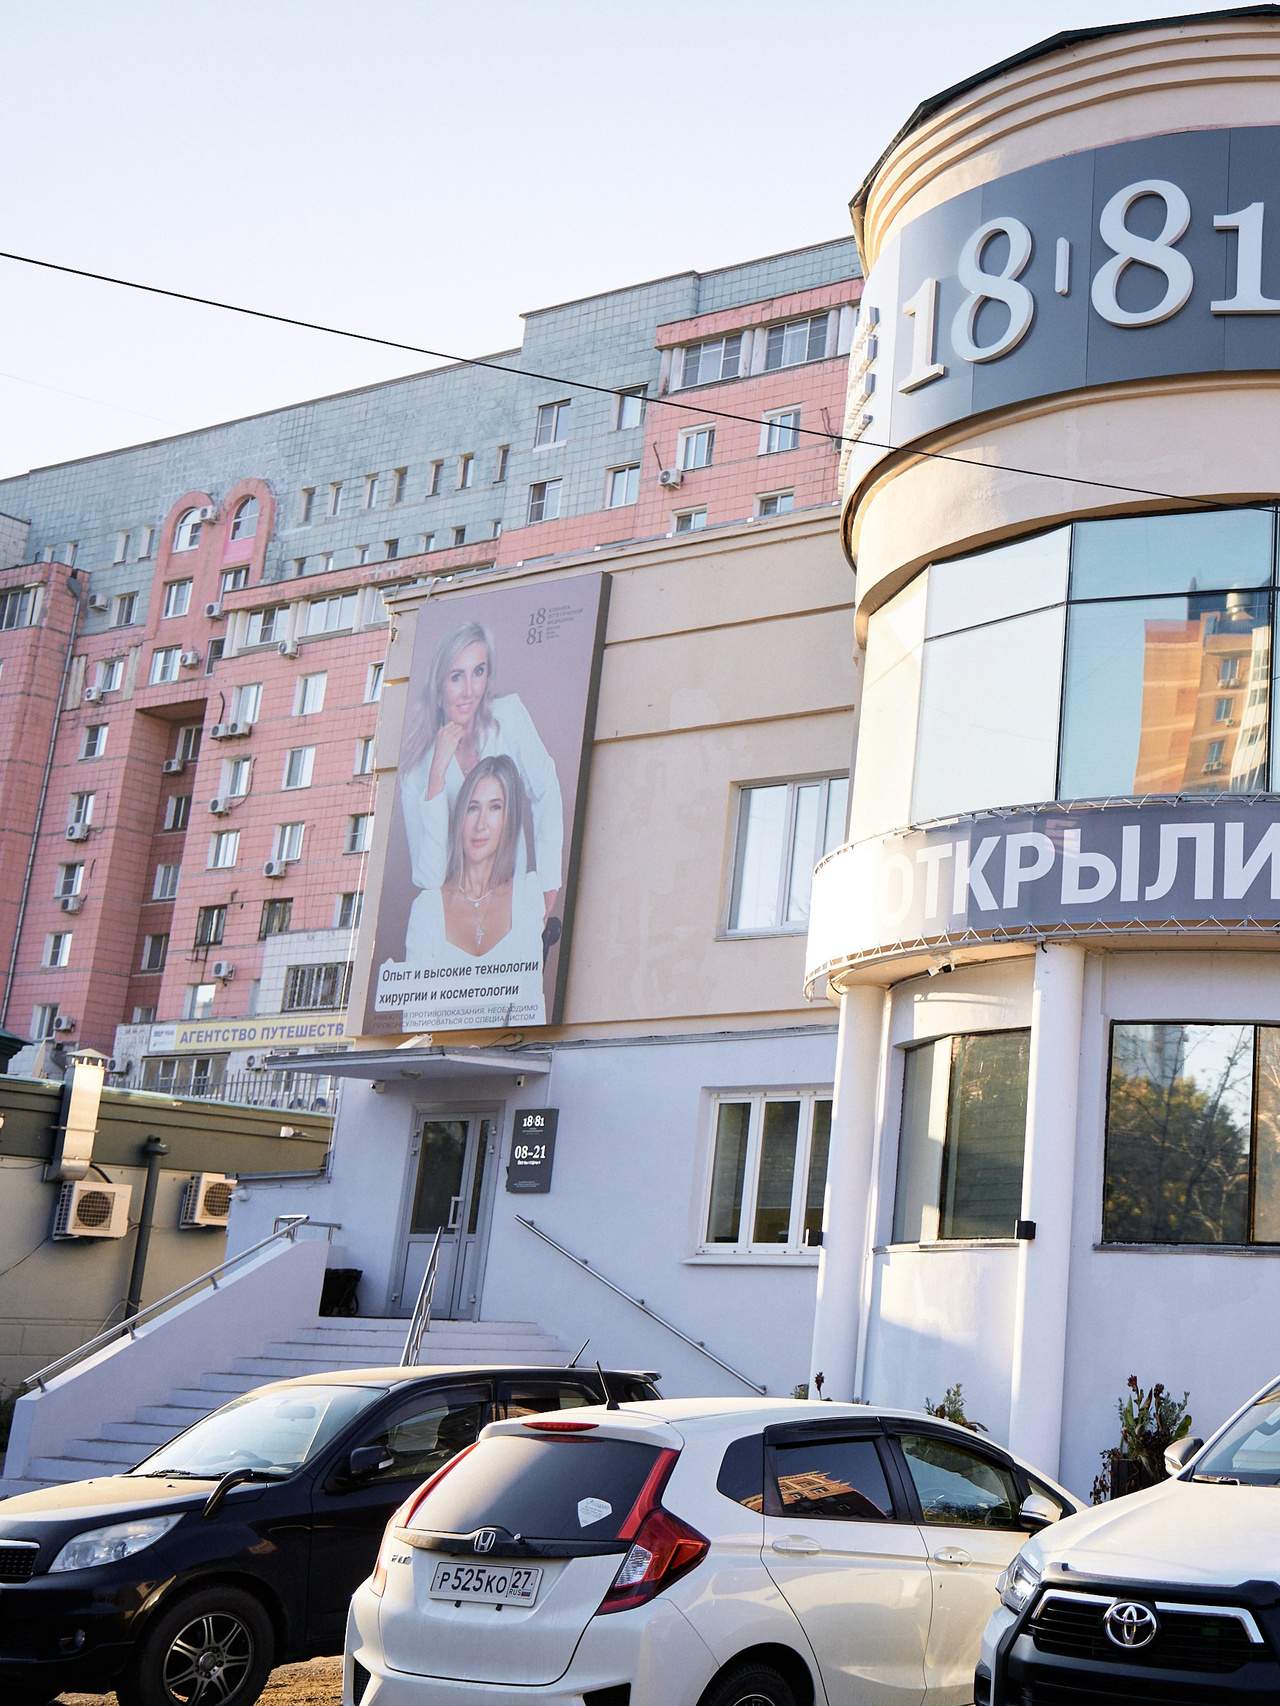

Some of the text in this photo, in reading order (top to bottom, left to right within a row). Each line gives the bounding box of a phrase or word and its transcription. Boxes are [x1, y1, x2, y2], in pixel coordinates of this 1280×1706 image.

[382, 961, 539, 982] Опыт и высокие технологии
[379, 985, 519, 1005] хирургии и косметологии
[488, 1004, 539, 1014] НЕОБХОДИМО
[180, 1028, 257, 1044] АГЕНТСТВО
[261, 1023, 344, 1040] ПУТЕШЕСТВ
[514, 1145, 546, 1159] 08-21
[511, 1571, 532, 1589] 27
[509, 1588, 522, 1596] RUS
